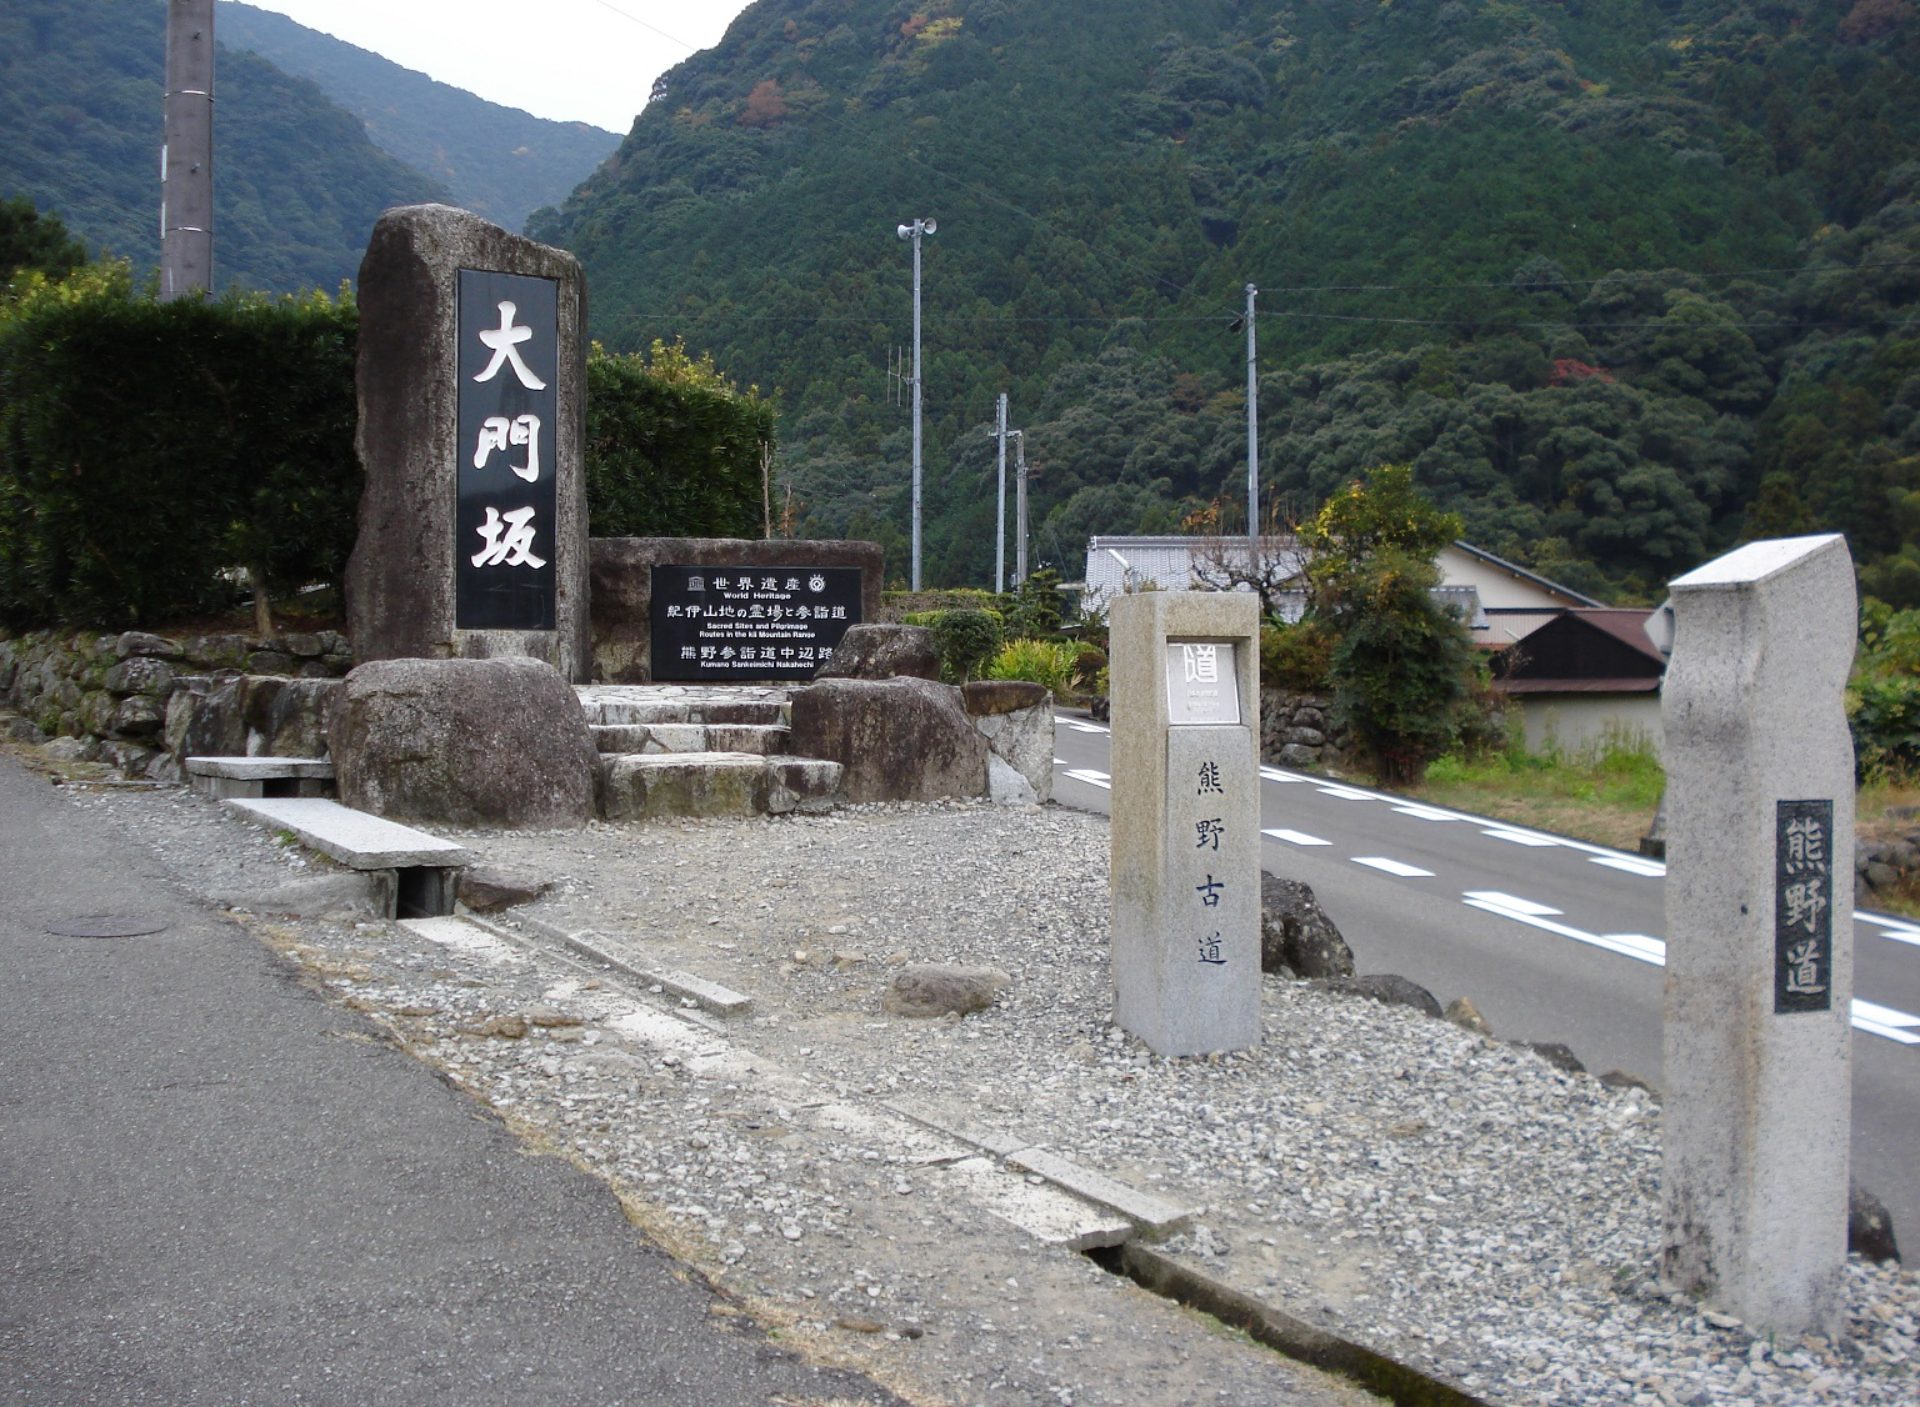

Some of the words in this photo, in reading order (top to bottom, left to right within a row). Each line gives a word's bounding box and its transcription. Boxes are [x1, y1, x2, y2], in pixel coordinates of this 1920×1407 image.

[471, 300, 547, 569] 大門坂
[712, 576, 801, 591] 世界遺産
[753, 592, 791, 600] Heritage
[666, 604, 847, 622] 紀伊山地の霊場と参詣道
[707, 622, 733, 630] Sacred
[734, 622, 753, 630] Sites
[770, 623, 808, 631] Pilgrimage
[699, 630, 724, 638] Routes
[726, 630, 733, 638] in
[734, 630, 747, 638] the
[792, 631, 816, 639] Range
[680, 646, 833, 660] 熊野参詣道中辺路
[700, 661, 730, 669] Kumano
[731, 661, 774, 669] Sankeimichi
[776, 661, 815, 669] Nakahechi
[1195, 761, 1228, 965] 熊野古道
[1785, 816, 1827, 994] 熊野道
